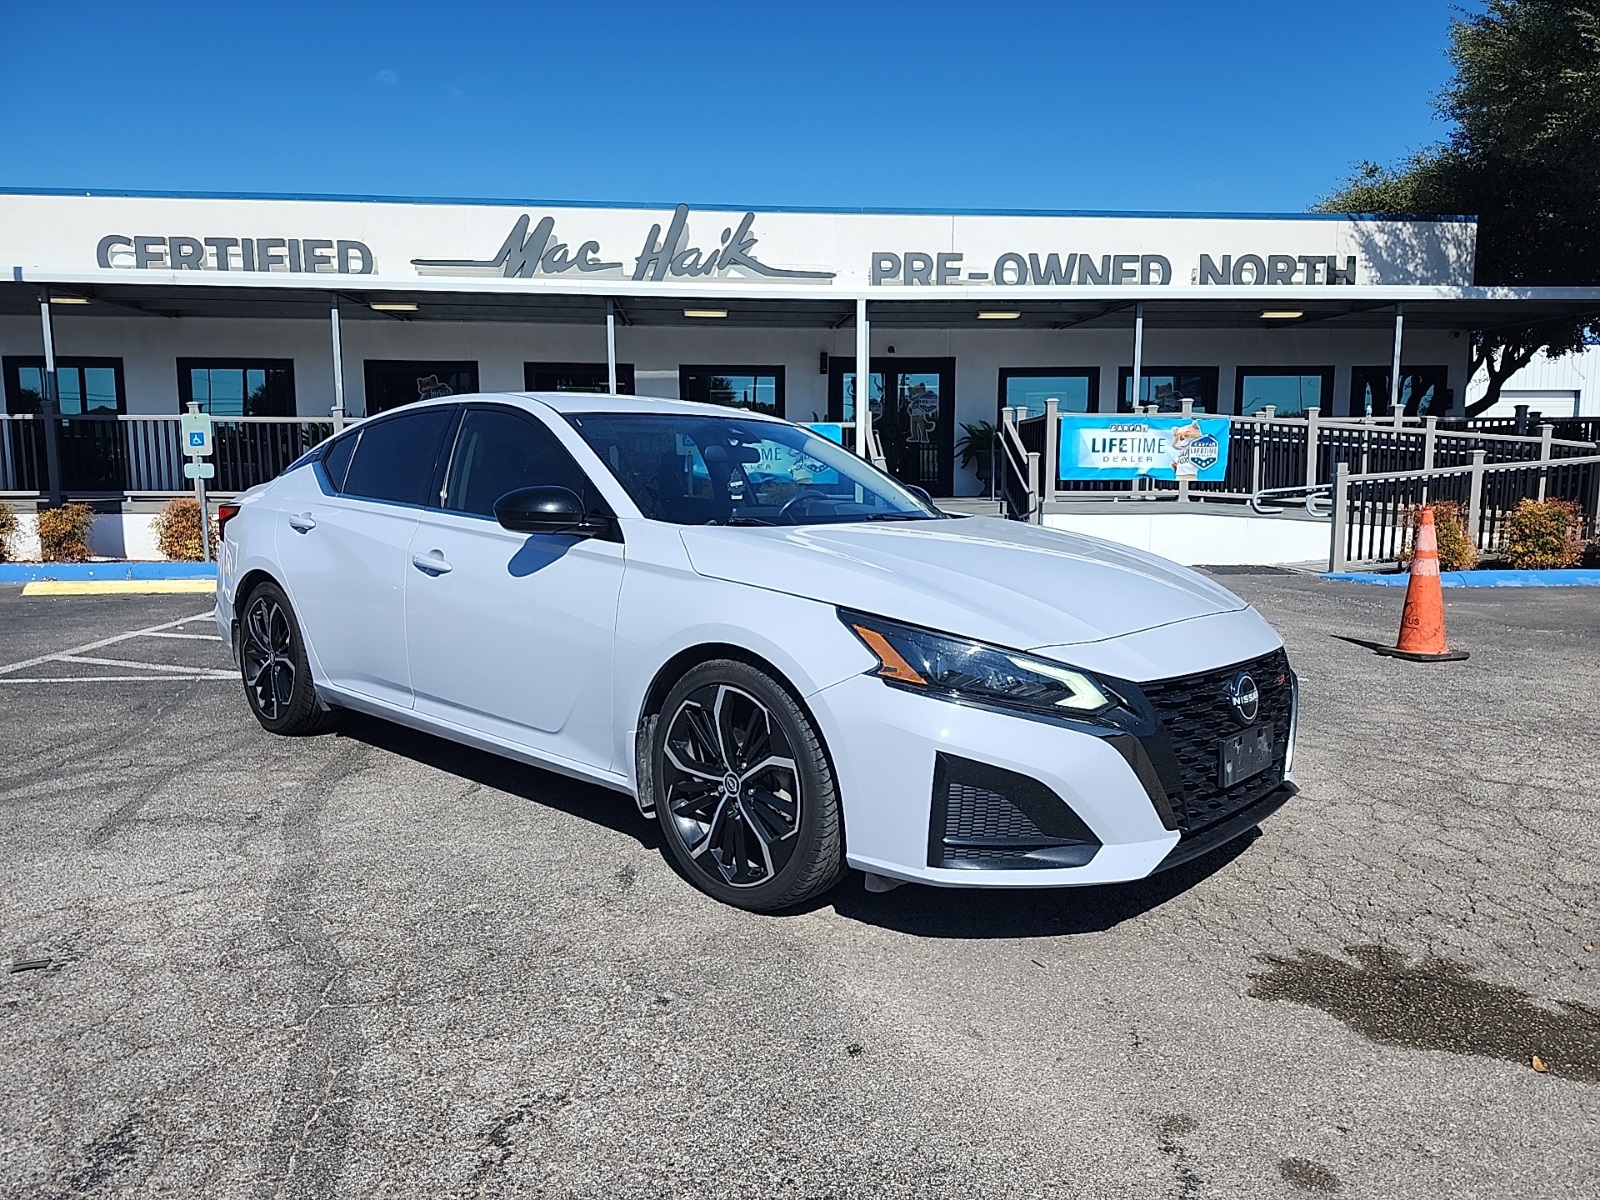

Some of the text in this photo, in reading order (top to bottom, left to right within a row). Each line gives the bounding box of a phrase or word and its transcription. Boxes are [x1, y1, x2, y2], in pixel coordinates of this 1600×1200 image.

[411, 203, 837, 281] Mac Haik
[97, 235, 373, 275] CERTIFIED
[871, 251, 1356, 285] PRE-OWNED NORTH
[1109, 424, 1148, 432] CARFAX
[1091, 437, 1166, 454] LIFETIME
[1402, 617, 1420, 626] TUS
